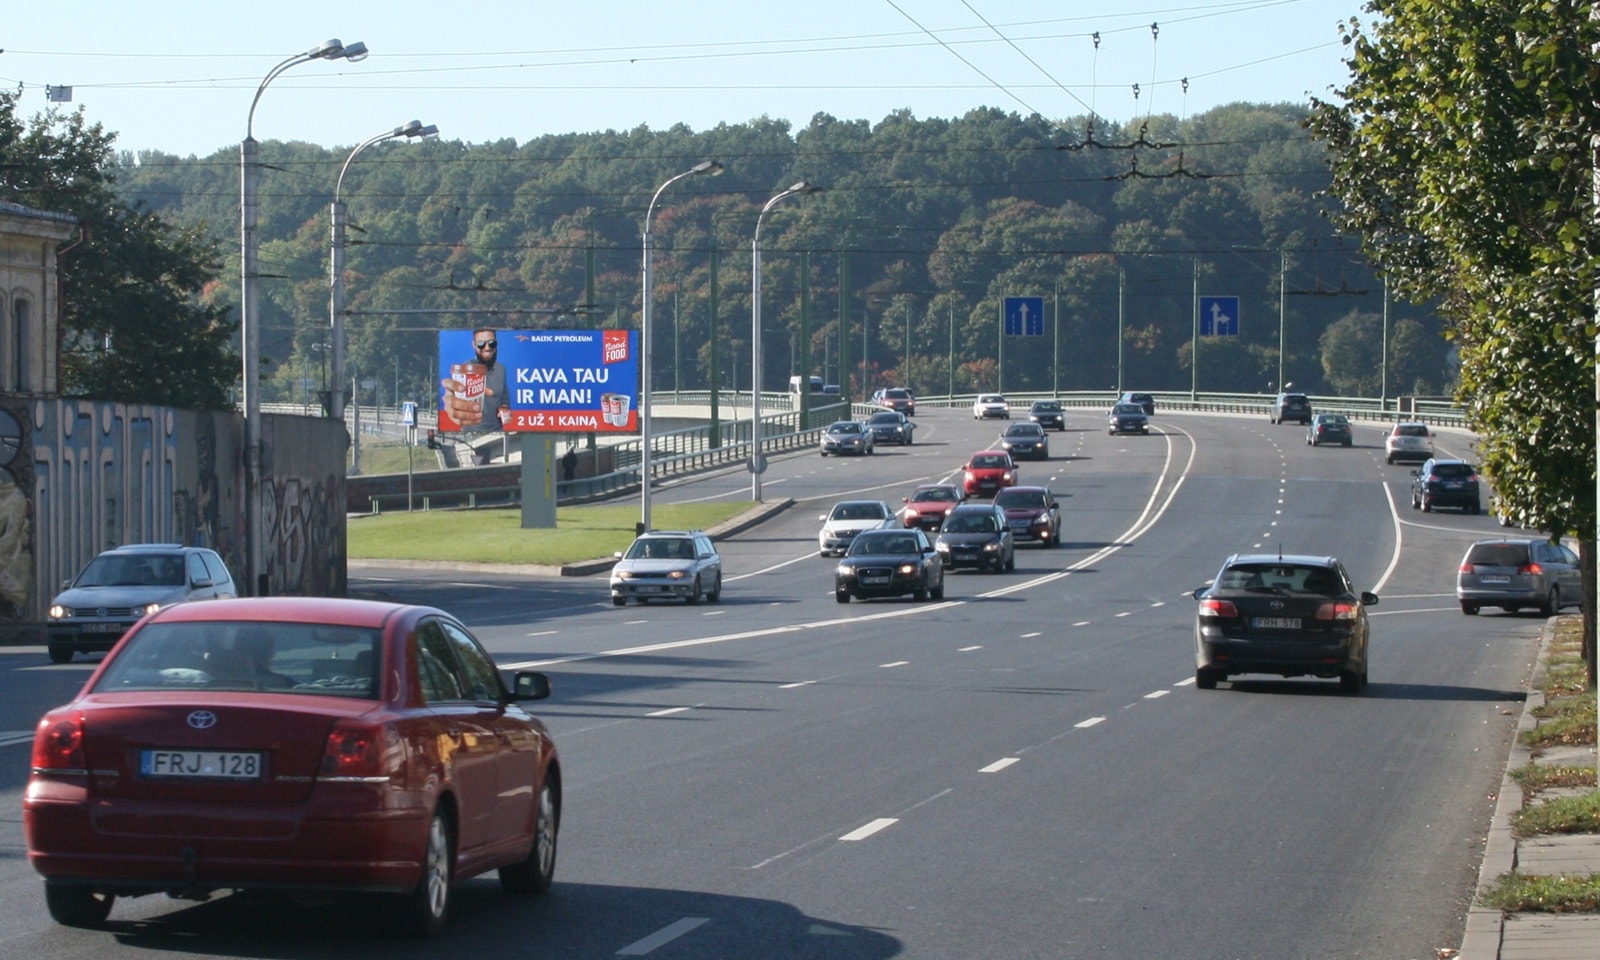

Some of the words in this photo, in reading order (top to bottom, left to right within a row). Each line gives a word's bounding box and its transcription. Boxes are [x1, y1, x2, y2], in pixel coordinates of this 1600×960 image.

[606, 348, 626, 361] FOOD
[516, 368, 568, 383] KAVA
[572, 368, 609, 383] TAU
[467, 382, 484, 396] FOOD
[516, 388, 534, 404] IR
[539, 388, 592, 404] MAN!
[517, 415, 525, 426] 2
[528, 412, 545, 426] UŽ
[548, 415, 554, 426] 1
[558, 415, 598, 429] KAINĄ
[154, 753, 202, 773] FRJ
[218, 755, 256, 775] 128
